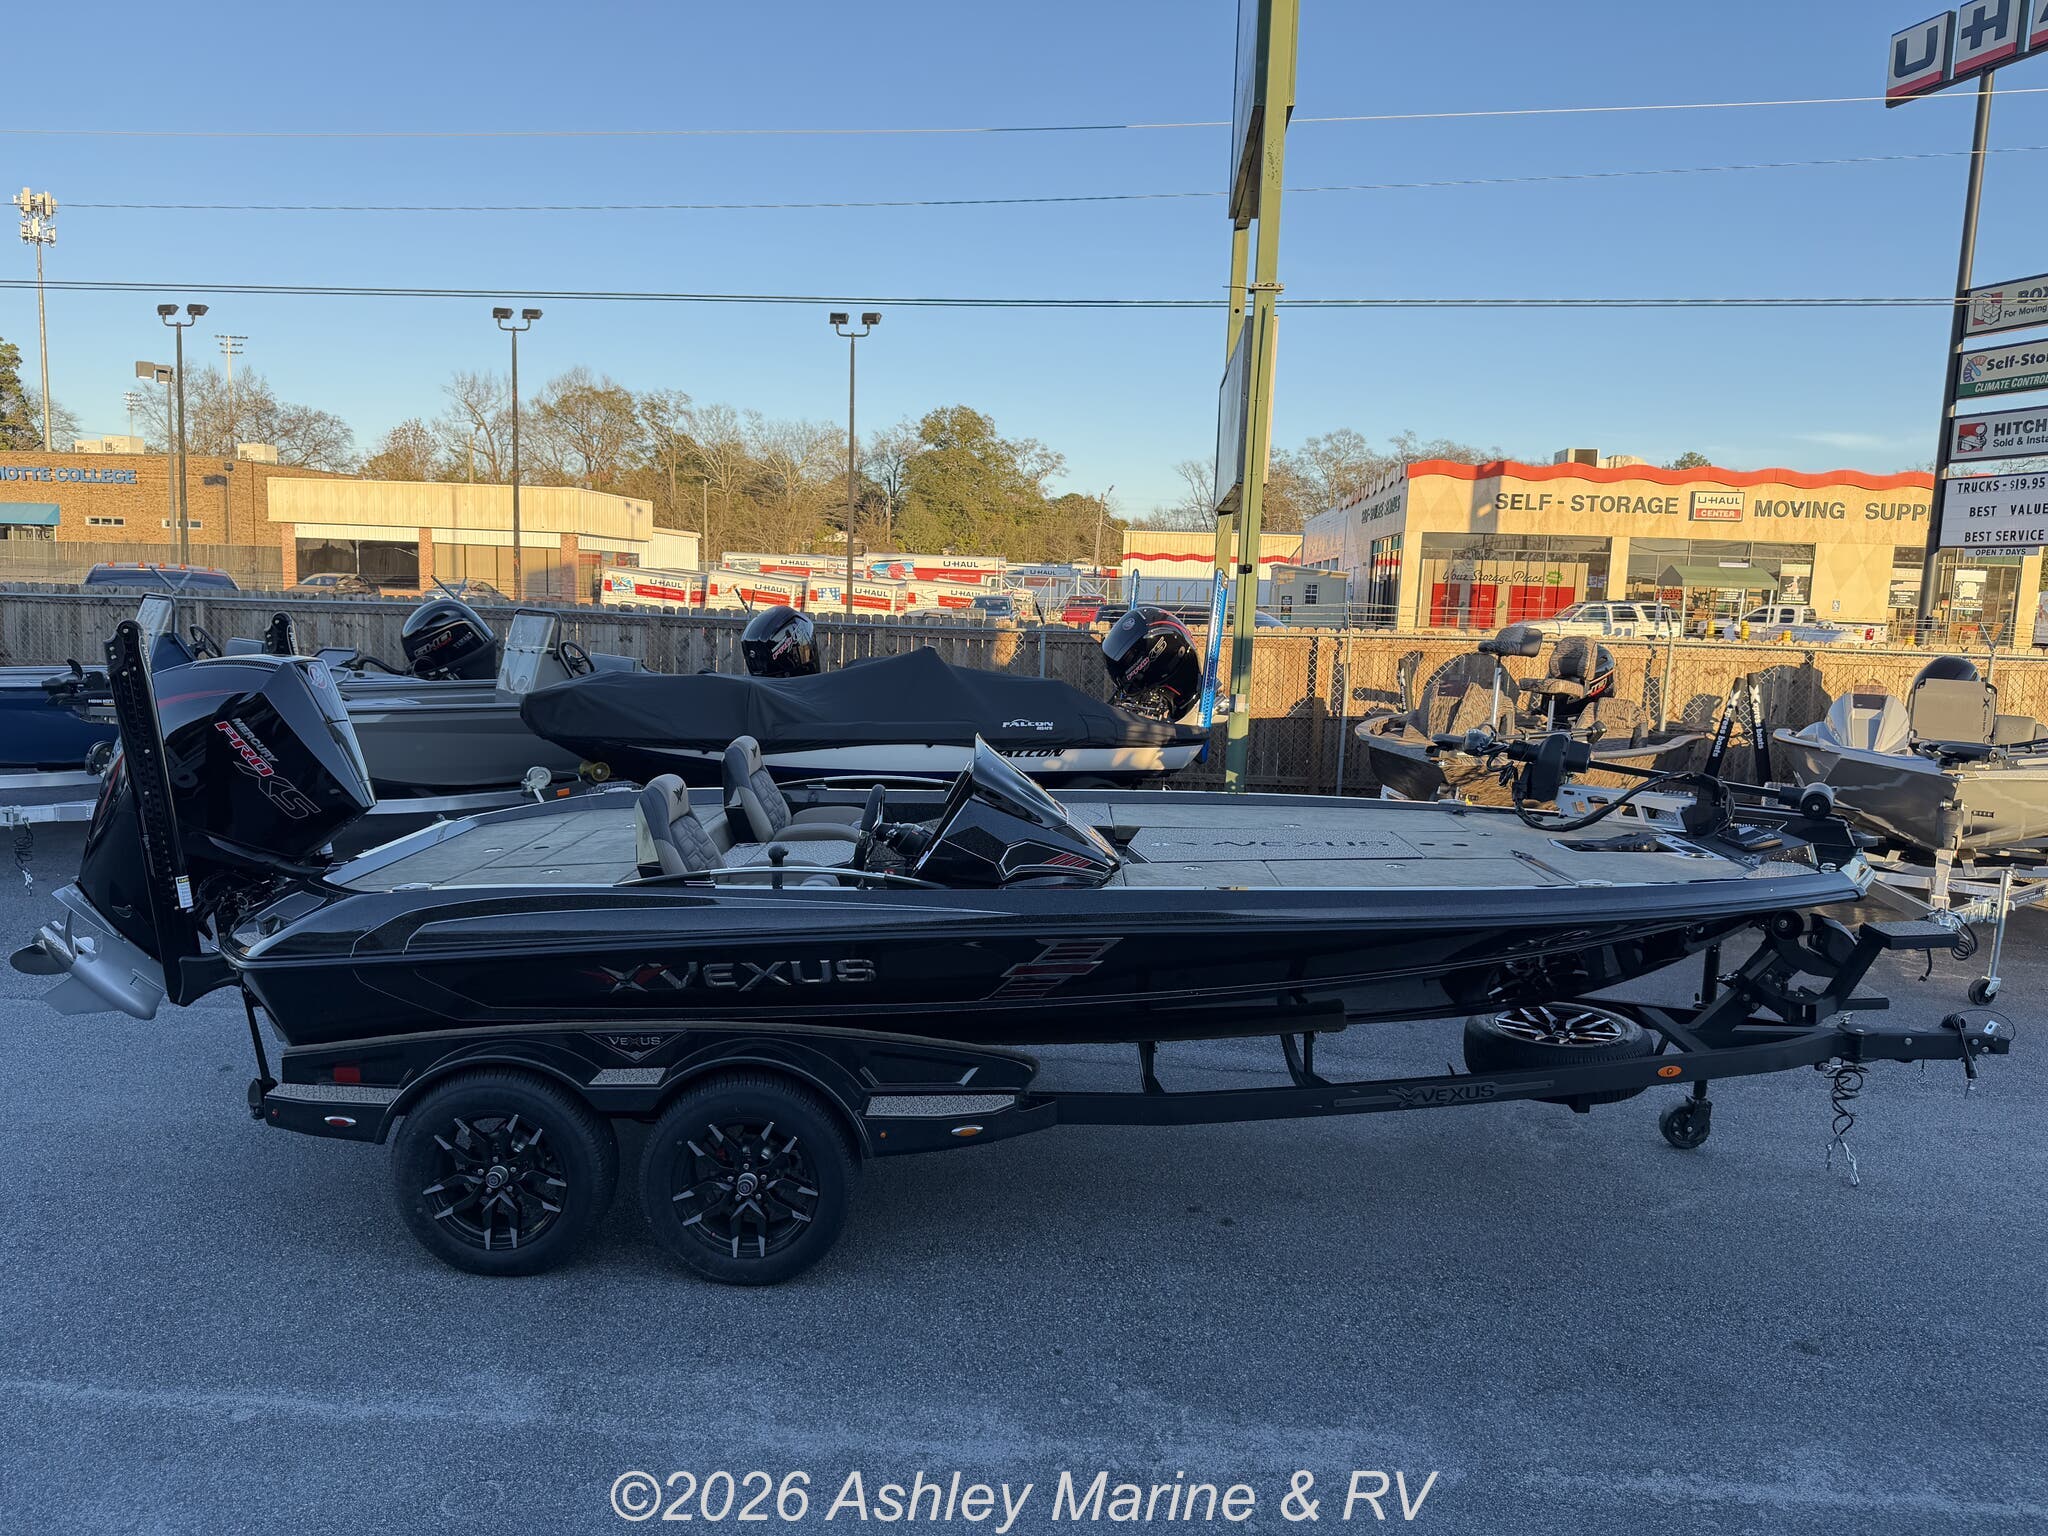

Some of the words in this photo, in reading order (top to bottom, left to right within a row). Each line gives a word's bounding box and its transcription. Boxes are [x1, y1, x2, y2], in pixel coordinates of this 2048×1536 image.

[2004, 309, 2016, 318] For
[2019, 304, 2048, 316] Moving
[1986, 353, 2048, 371] Self-Sto
[1974, 379, 2009, 393] CLIMATE
[1993, 418, 2048, 437] HITCH
[1993, 438, 2014, 448] Sold
[2016, 437, 2024, 445] &
[55, 468, 137, 484] COLLEGE
[1957, 480, 2000, 494] TRUCKS
[2010, 477, 2046, 490] $19.95
[1495, 493, 1552, 511] SELF
[1570, 494, 1679, 514] STORAGE
[1697, 495, 1740, 505] U-HAUL
[1701, 509, 1736, 518] CENTER
[1754, 499, 1846, 519] MOVING
[1865, 502, 1930, 521] SUPP
[1969, 505, 1997, 517] BEST
[1964, 531, 1992, 543] BEST
[1995, 529, 2045, 542] SERVICE
[2005, 548, 2026, 556] DAYS
[1442, 568, 1469, 583] Your
[1471, 569, 1512, 584] Storage
[1514, 570, 1544, 583] Place
[1002, 720, 1054, 728] FALCON
[232, 717, 279, 762] MERCURY
[1712, 735, 1726, 758] boats
[1755, 728, 1765, 749] boats
[214, 721, 275, 777] PRO
[999, 749, 1066, 758] ALCON
[648, 959, 878, 992] VEXUS
[608, 1036, 662, 1047] VEXUS
[1418, 1084, 1496, 1103] VEXUS
